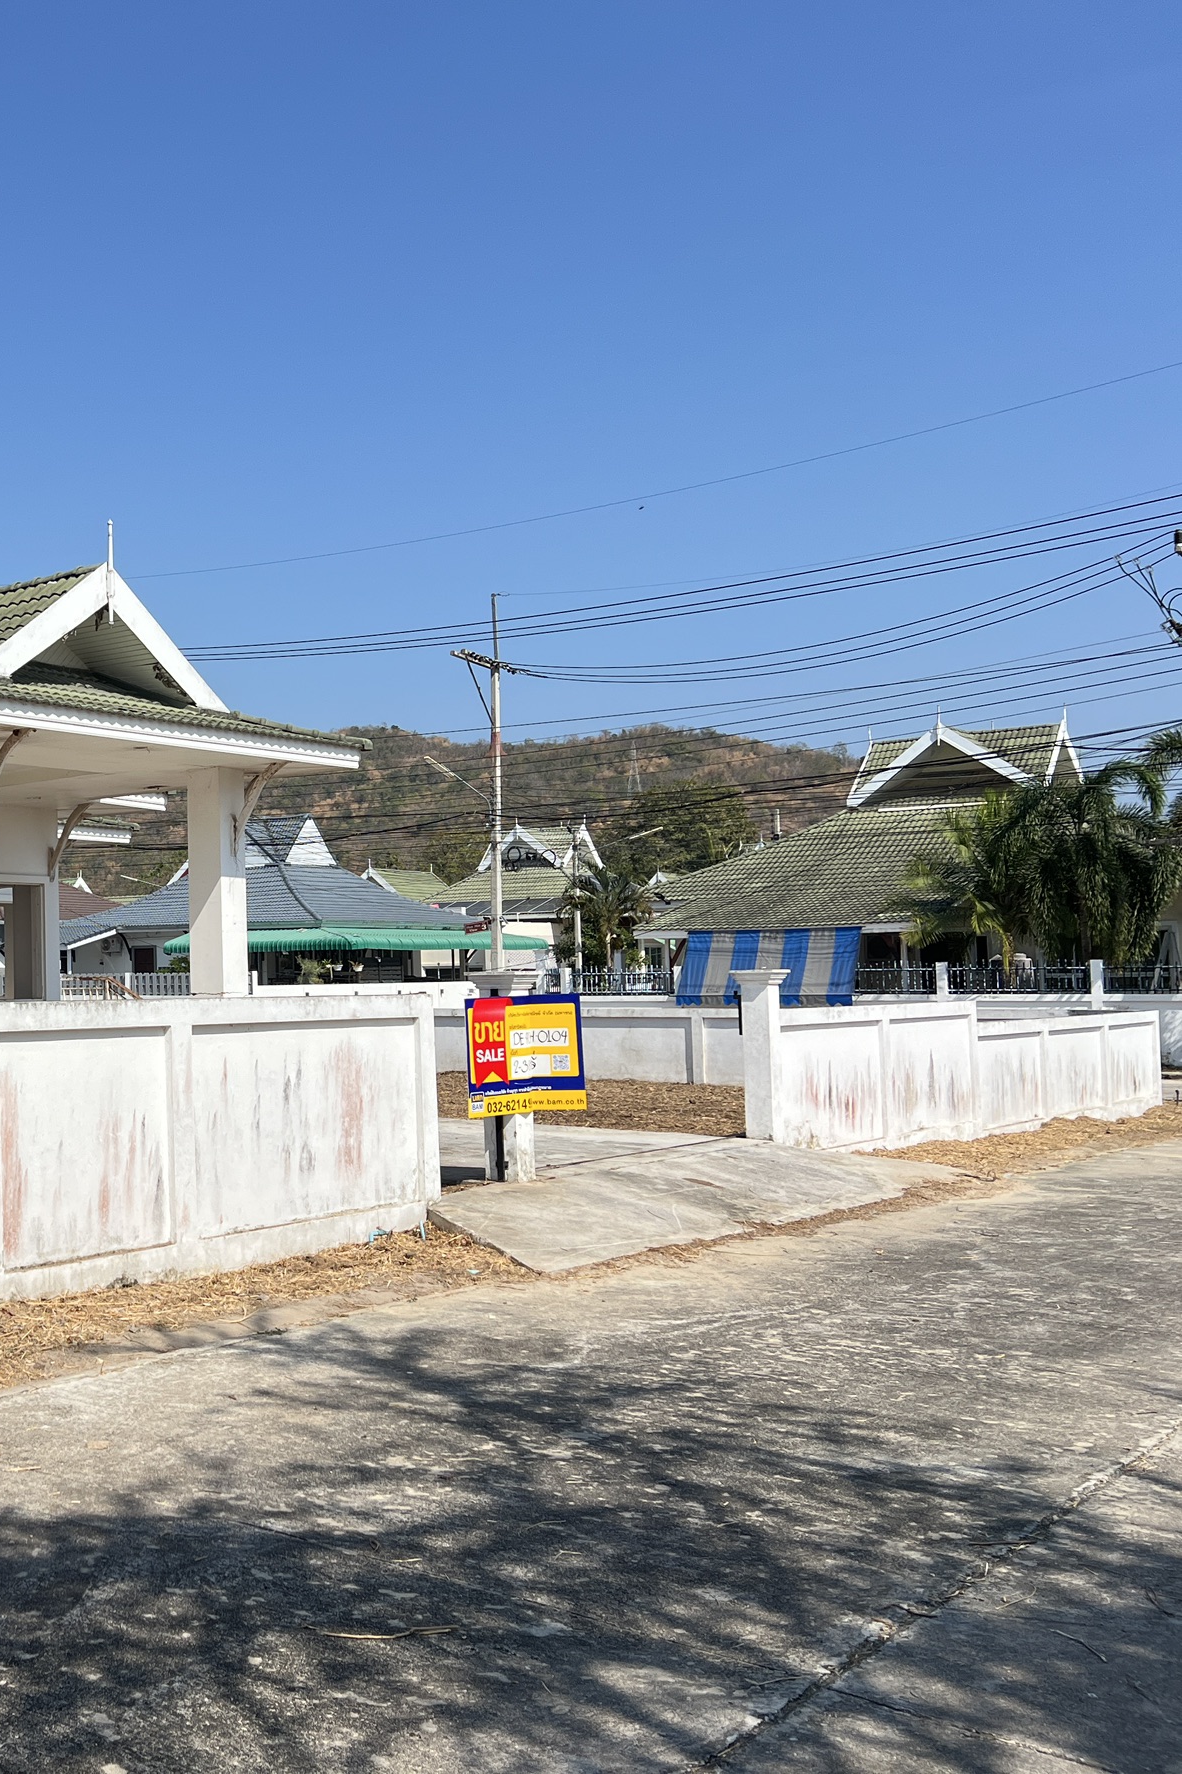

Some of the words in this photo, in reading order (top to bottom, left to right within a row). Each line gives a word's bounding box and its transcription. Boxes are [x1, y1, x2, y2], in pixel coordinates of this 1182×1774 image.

[474, 1021, 504, 1043] ขาย
[513, 1030, 567, 1046] DEH-0104
[476, 1048, 504, 1063] SALE
